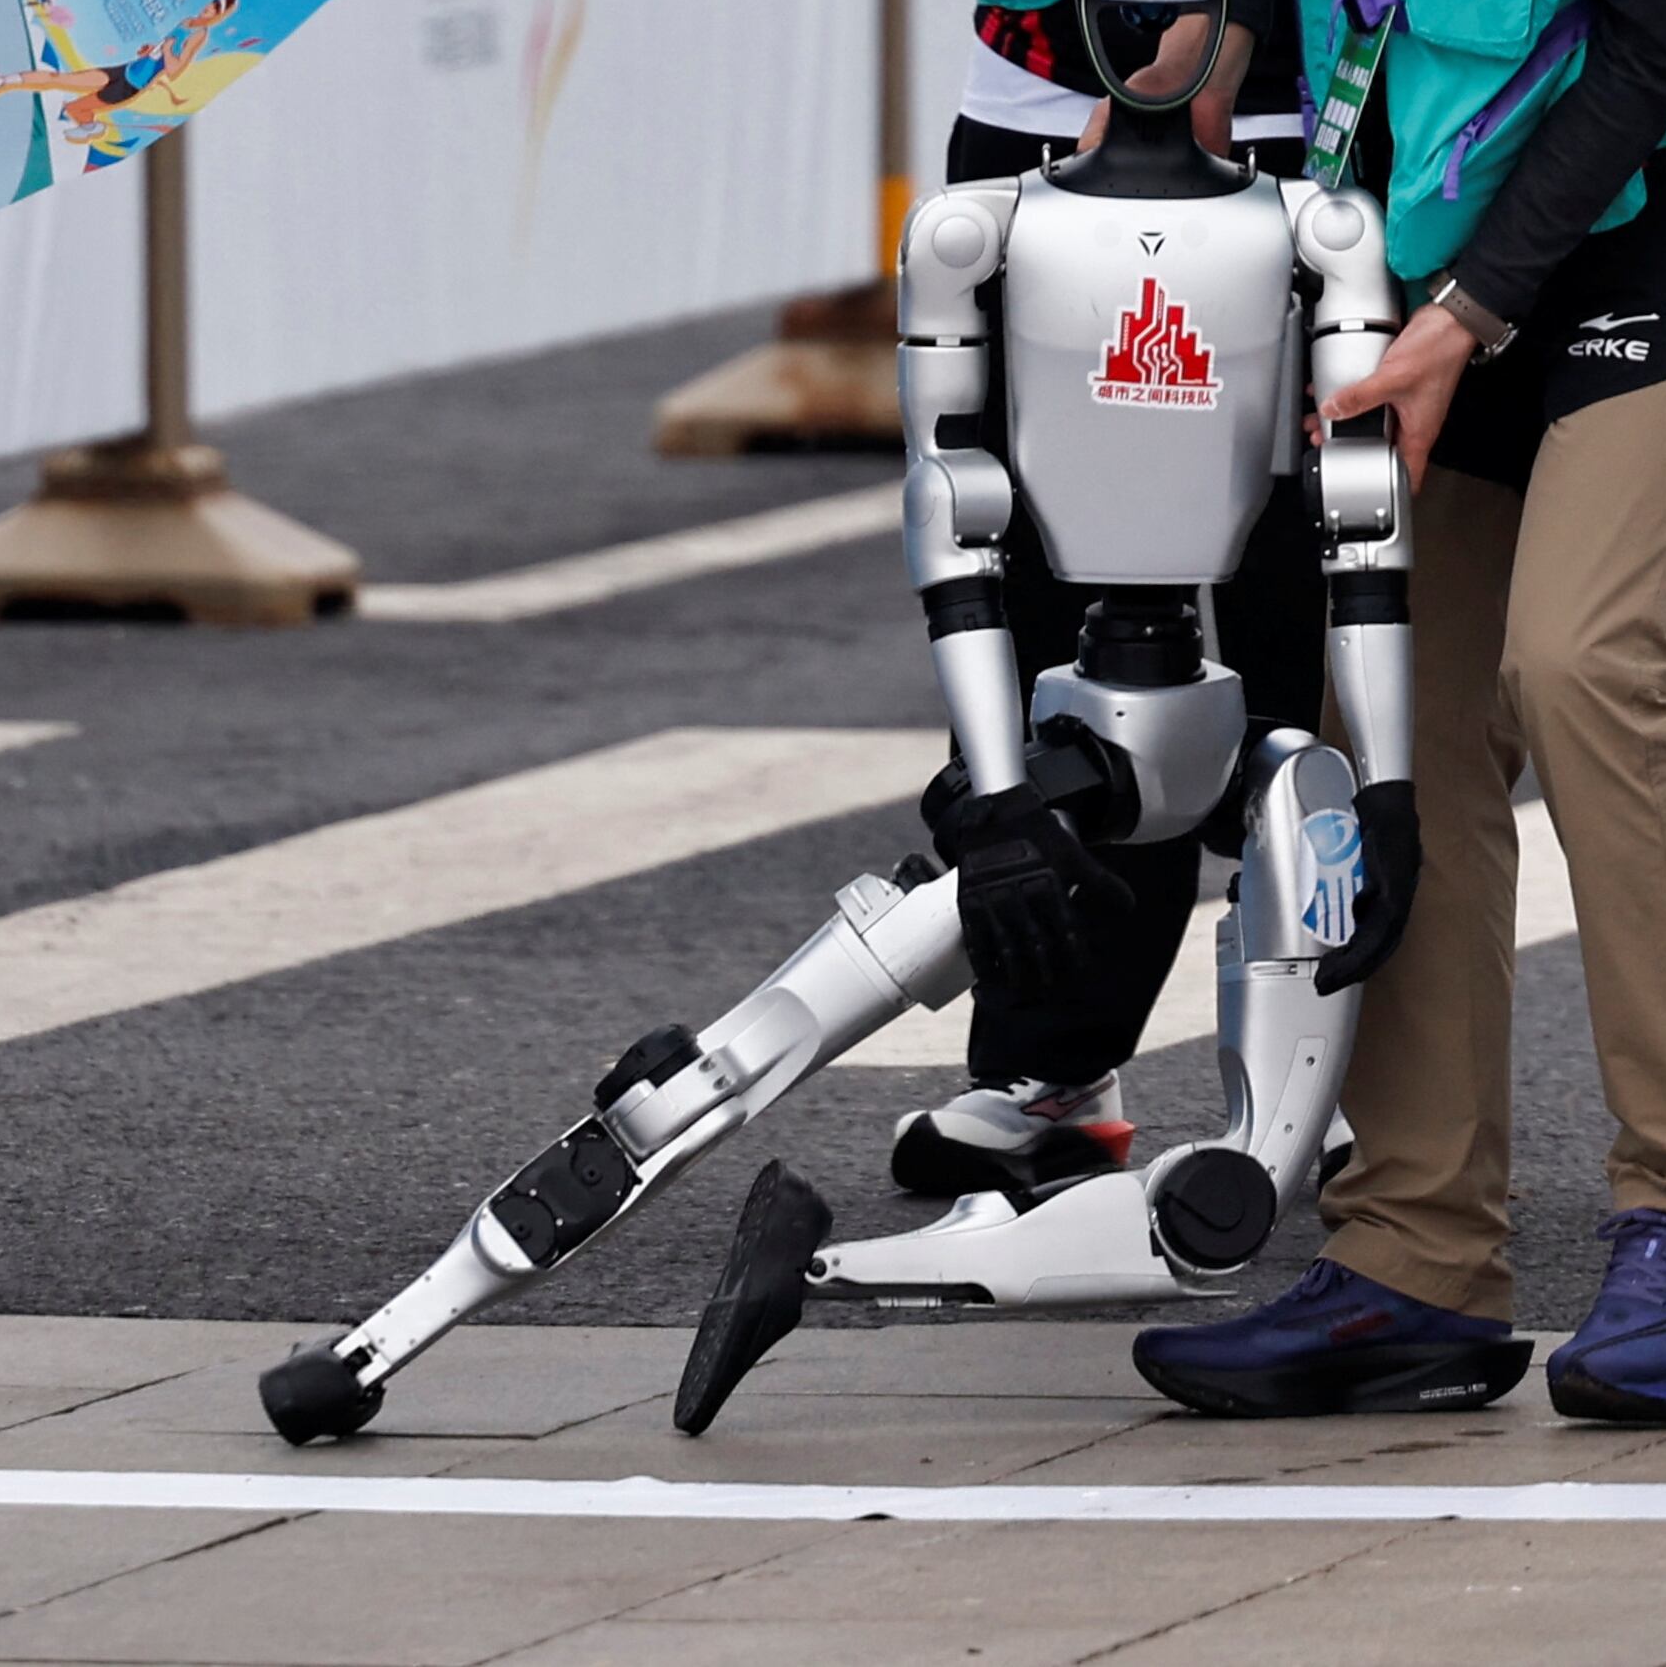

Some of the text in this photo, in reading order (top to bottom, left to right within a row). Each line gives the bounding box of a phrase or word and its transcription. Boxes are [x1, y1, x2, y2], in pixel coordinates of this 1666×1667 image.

[1567, 337, 1651, 362] ERKE
[1097, 384, 1213, 406] 城市之间科技队
